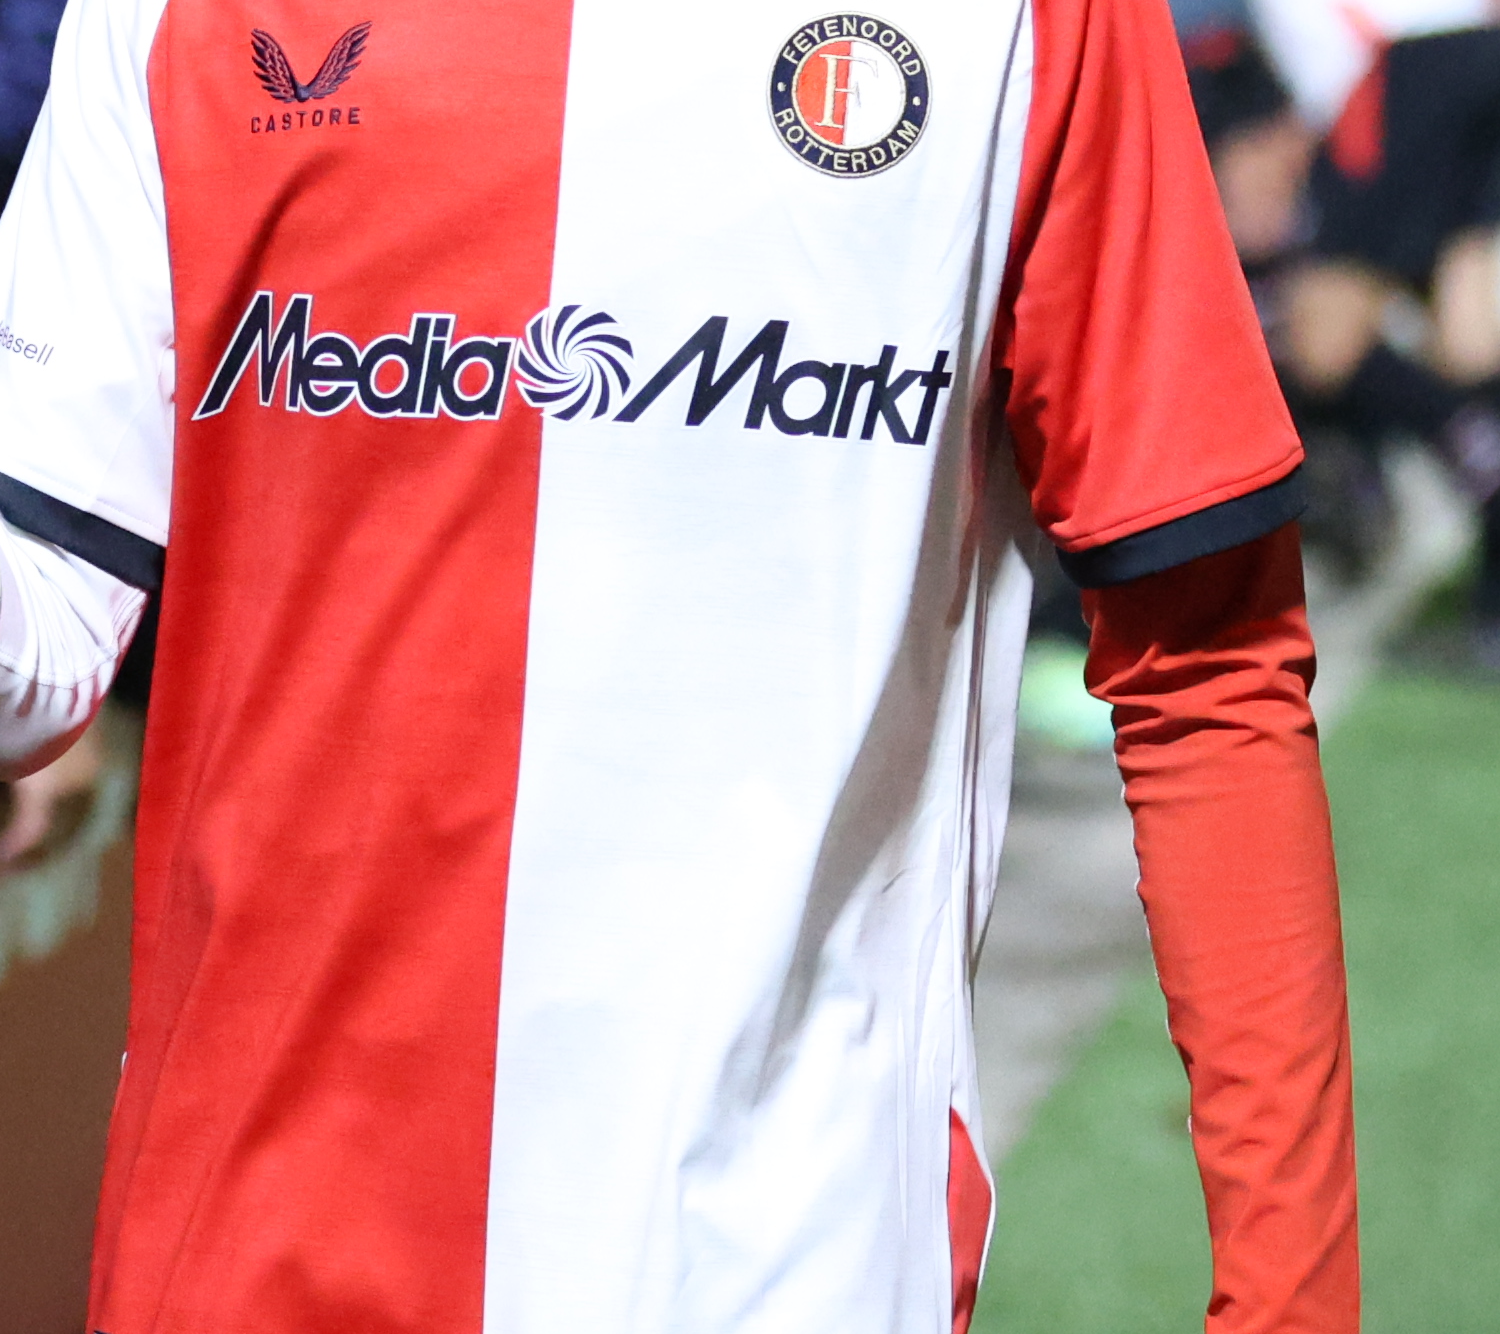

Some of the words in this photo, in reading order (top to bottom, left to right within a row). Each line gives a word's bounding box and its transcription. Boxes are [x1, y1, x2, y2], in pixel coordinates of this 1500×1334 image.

[782, 16, 921, 77] FEYENOORD
[250, 106, 361, 134] CASTORE
[774, 108, 920, 172] ROTTERDAM
[190, 290, 517, 421] Media
[608, 314, 953, 447] Markt
